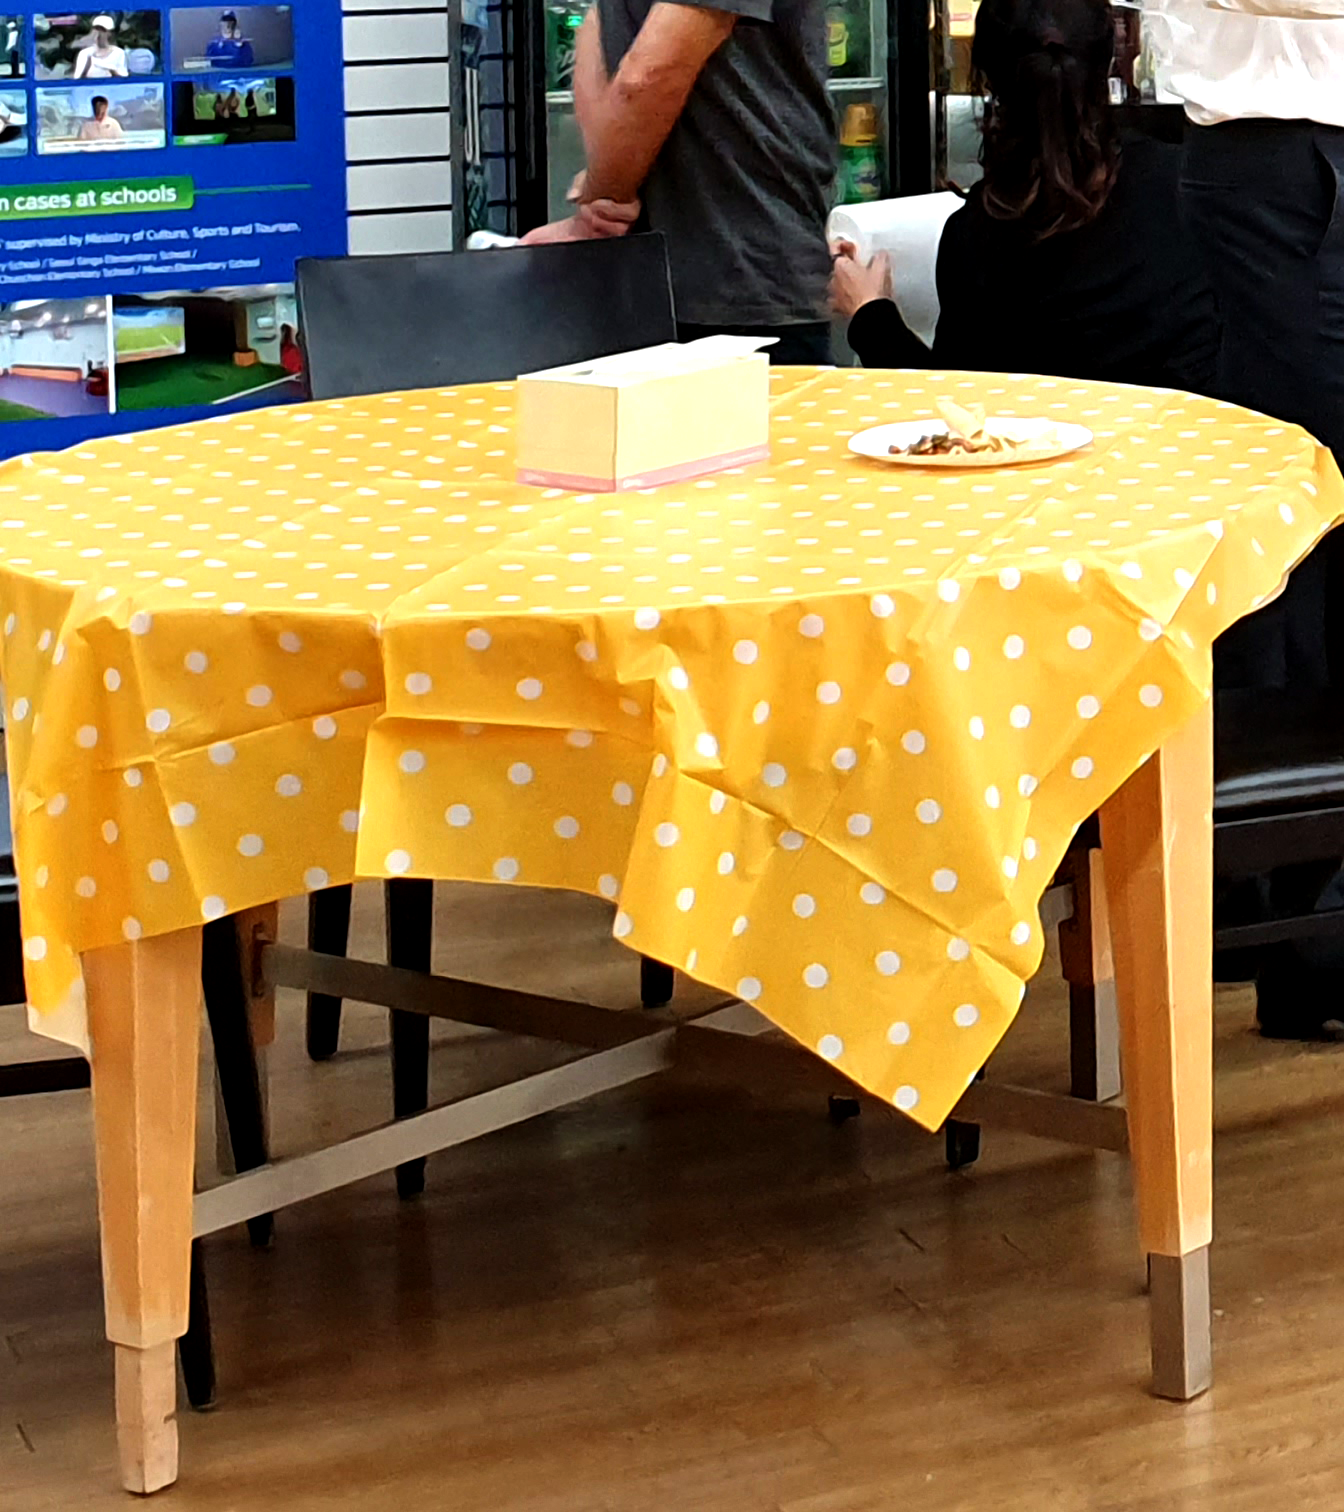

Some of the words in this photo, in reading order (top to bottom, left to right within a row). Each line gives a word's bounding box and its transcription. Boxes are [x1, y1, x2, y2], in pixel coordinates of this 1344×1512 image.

[14, 192, 72, 211] cases
[76, 188, 97, 208] at
[101, 184, 177, 205] schools
